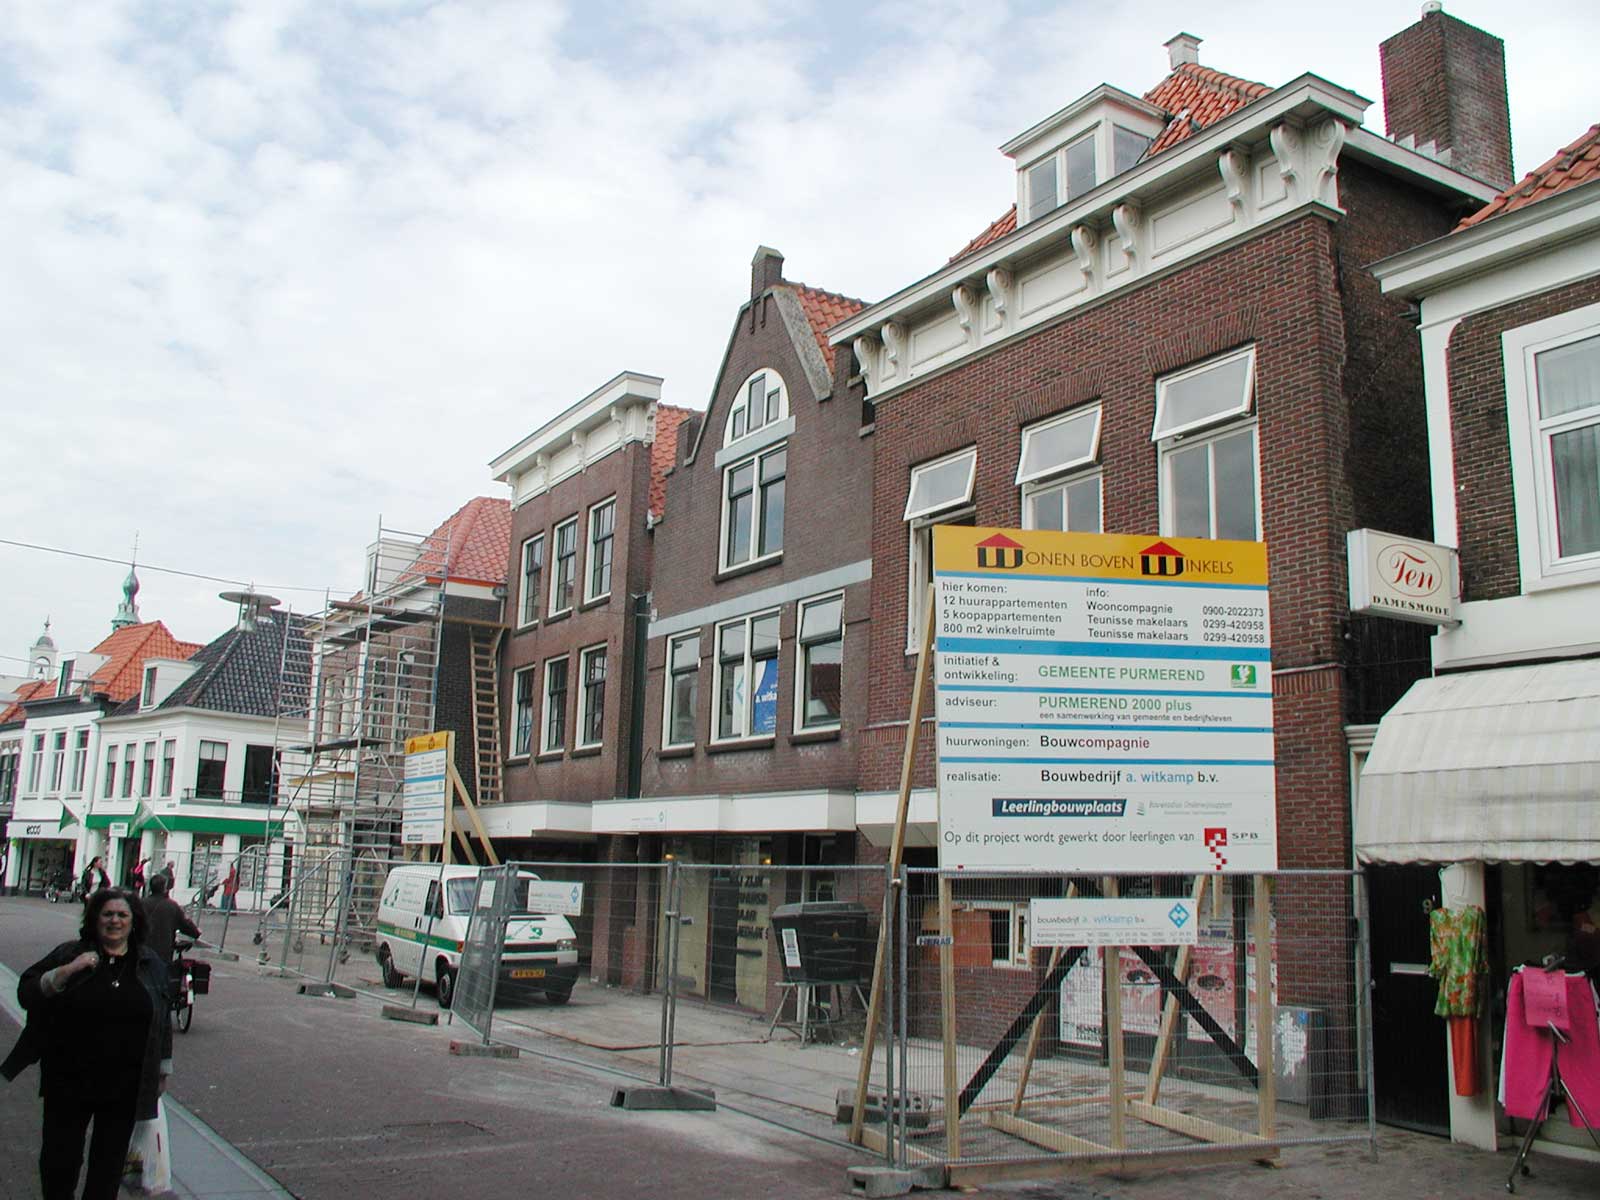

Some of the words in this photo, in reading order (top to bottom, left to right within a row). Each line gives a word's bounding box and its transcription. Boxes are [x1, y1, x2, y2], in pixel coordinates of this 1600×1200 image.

[977, 546, 1075, 569] WONEN
[1081, 553, 1134, 570] BOVEN
[1141, 555, 1234, 577] WINKELS
[1390, 550, 1435, 591] Ten
[942, 581, 963, 592] hier
[966, 582, 1008, 594] komen:
[1086, 587, 1110, 598] info:
[943, 596, 956, 606] 12
[959, 596, 1068, 610] huurappartementen
[1086, 602, 1173, 615] Wooncompagnie
[1202, 605, 1264, 617] 0900-2022373
[1373, 595, 1450, 616] DAMESMODE
[943, 609, 950, 619] 5
[952, 609, 1062, 623] koopappartementen
[1087, 614, 1134, 625] Teunisse
[1136, 616, 1188, 628] makelaars
[1202, 619, 1265, 630] 0299-420958
[943, 623, 963, 634] 800
[966, 624, 983, 634] m2
[986, 624, 1056, 637] winkelruimte
[1088, 628, 1134, 639] Teunisse
[1136, 630, 1189, 642] makelaars
[1203, 632, 1265, 644] 0299-420958
[944, 655, 989, 666] initiatief
[991, 656, 1000, 667] &
[944, 670, 1019, 683] ontwikkeling:
[1038, 665, 1116, 680] GEMEENTE
[1120, 667, 1205, 682] PURMEREND
[945, 696, 997, 707] adviseur:
[1038, 696, 1128, 710] PURMEREND
[1132, 698, 1161, 711] 2000
[1165, 699, 1193, 713] plus
[1056, 712, 1115, 722] samenwerking
[1132, 714, 1171, 723] gemeente
[1172, 714, 1182, 722] en
[1183, 714, 1232, 724] bedrijfsleven
[945, 736, 1030, 749] huurwoningen:
[1040, 735, 1150, 751] Bouwcompagnie
[946, 771, 1001, 782] realisatie:
[1040, 769, 1122, 785] Bouwbedrijf
[1126, 773, 1136, 783] a.
[1141, 771, 1195, 786] witkamp
[1197, 772, 1219, 784] b.v.
[1001, 800, 1123, 816] Leerlingbouwplaats
[944, 831, 962, 845] Op
[965, 831, 979, 843] dit
[983, 832, 1021, 846] project
[1023, 832, 1055, 843] wordt
[1058, 832, 1098, 845] gewerkt
[1102, 831, 1127, 843] door
[1129, 831, 1176, 845] leerlingen
[1178, 832, 1195, 842] van
[1231, 832, 1259, 840] SPB
[1037, 915, 1080, 925] bouwbedrijf
[1093, 915, 1134, 926] witkamp
